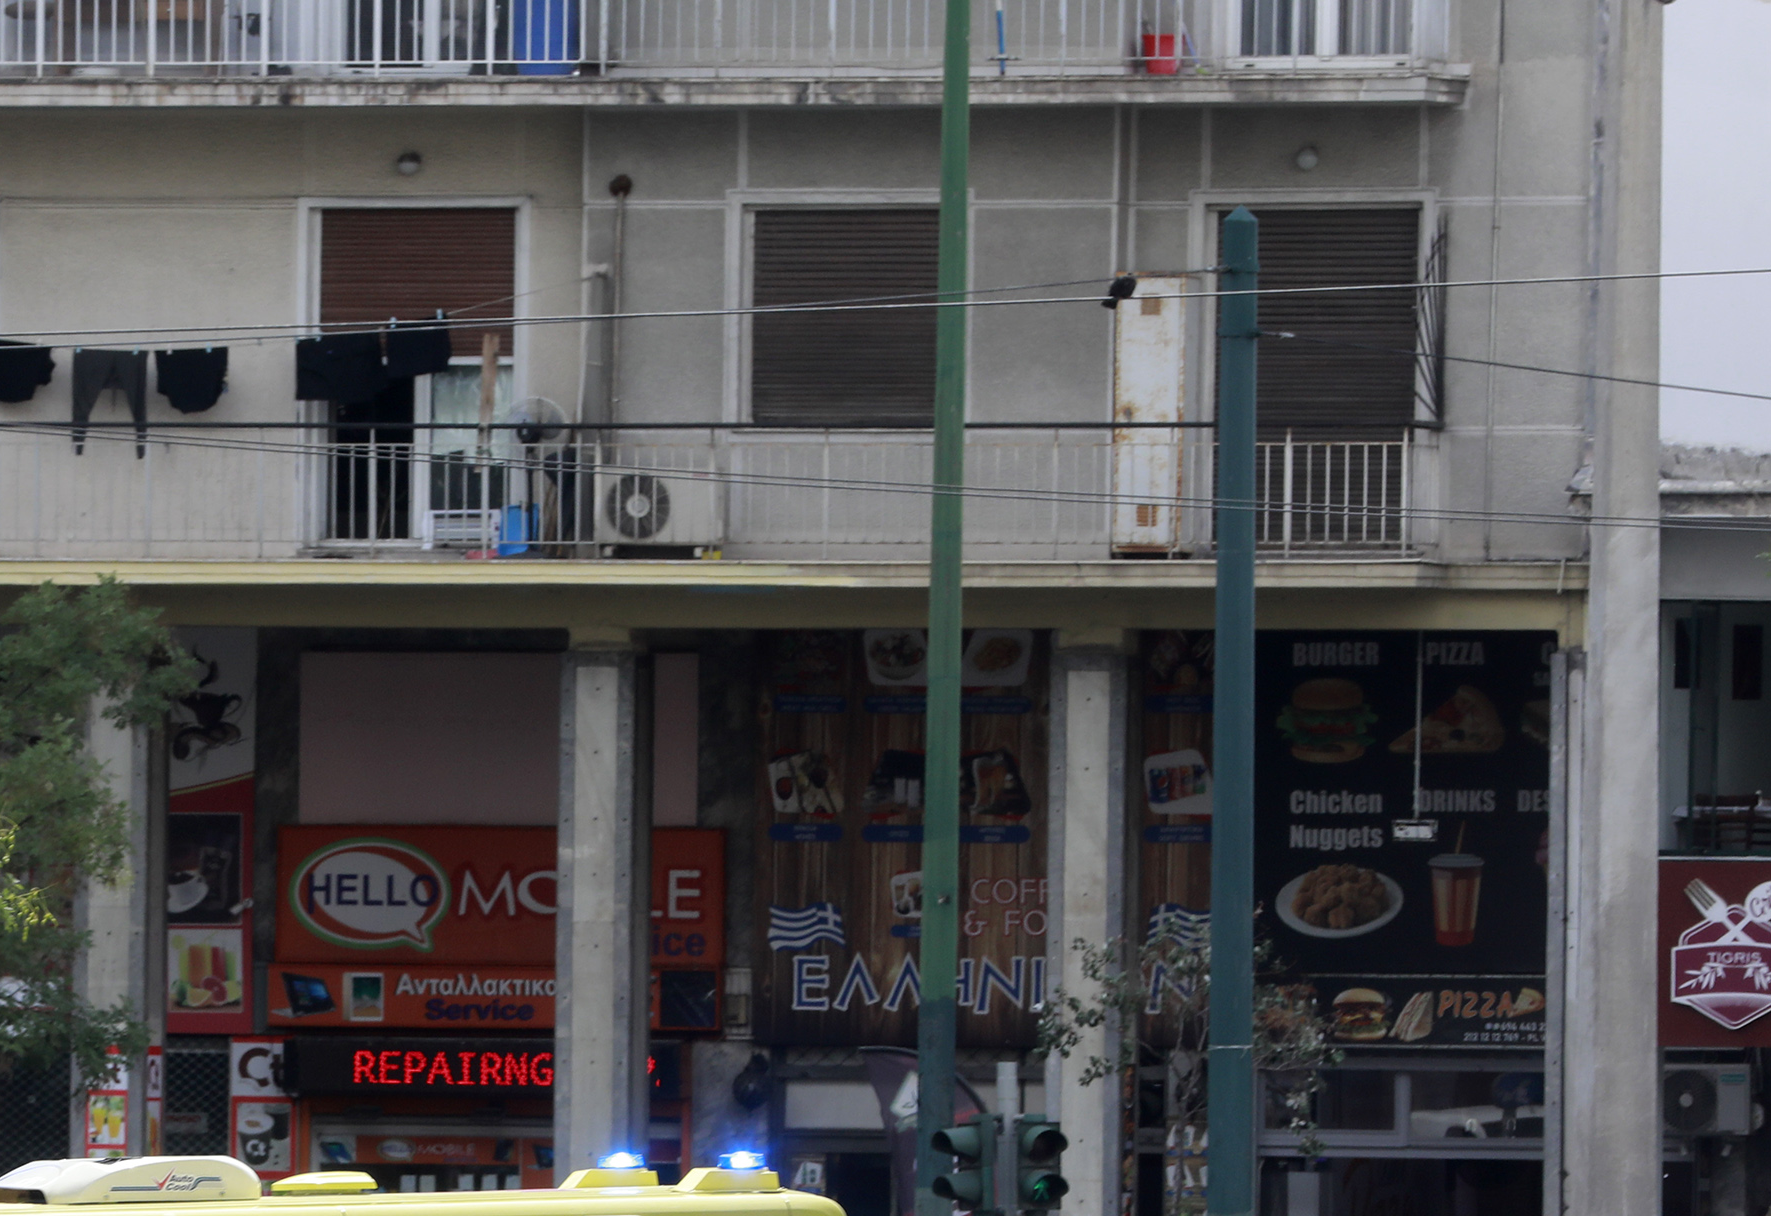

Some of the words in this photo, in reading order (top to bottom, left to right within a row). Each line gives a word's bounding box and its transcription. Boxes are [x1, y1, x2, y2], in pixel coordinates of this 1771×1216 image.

[1293, 641, 1381, 667] BURGER
[1425, 641, 1486, 667] PIZZA
[1289, 789, 1384, 814] Chicken
[1418, 789, 1497, 814] DRINKS
[1289, 824, 1384, 851] Nuggets
[308, 873, 440, 914] HELLO
[970, 878, 1048, 905] COFF
[963, 909, 988, 936] &
[1004, 909, 1048, 936] FO
[1706, 951, 1763, 964] TIGRIS
[425, 998, 536, 1023] Service
[1436, 988, 1514, 1019] PIZZA
[352, 1049, 555, 1086] REPAIRNG
[165, 1182, 192, 1191] Cool
[169, 1173, 195, 1182] Auto
